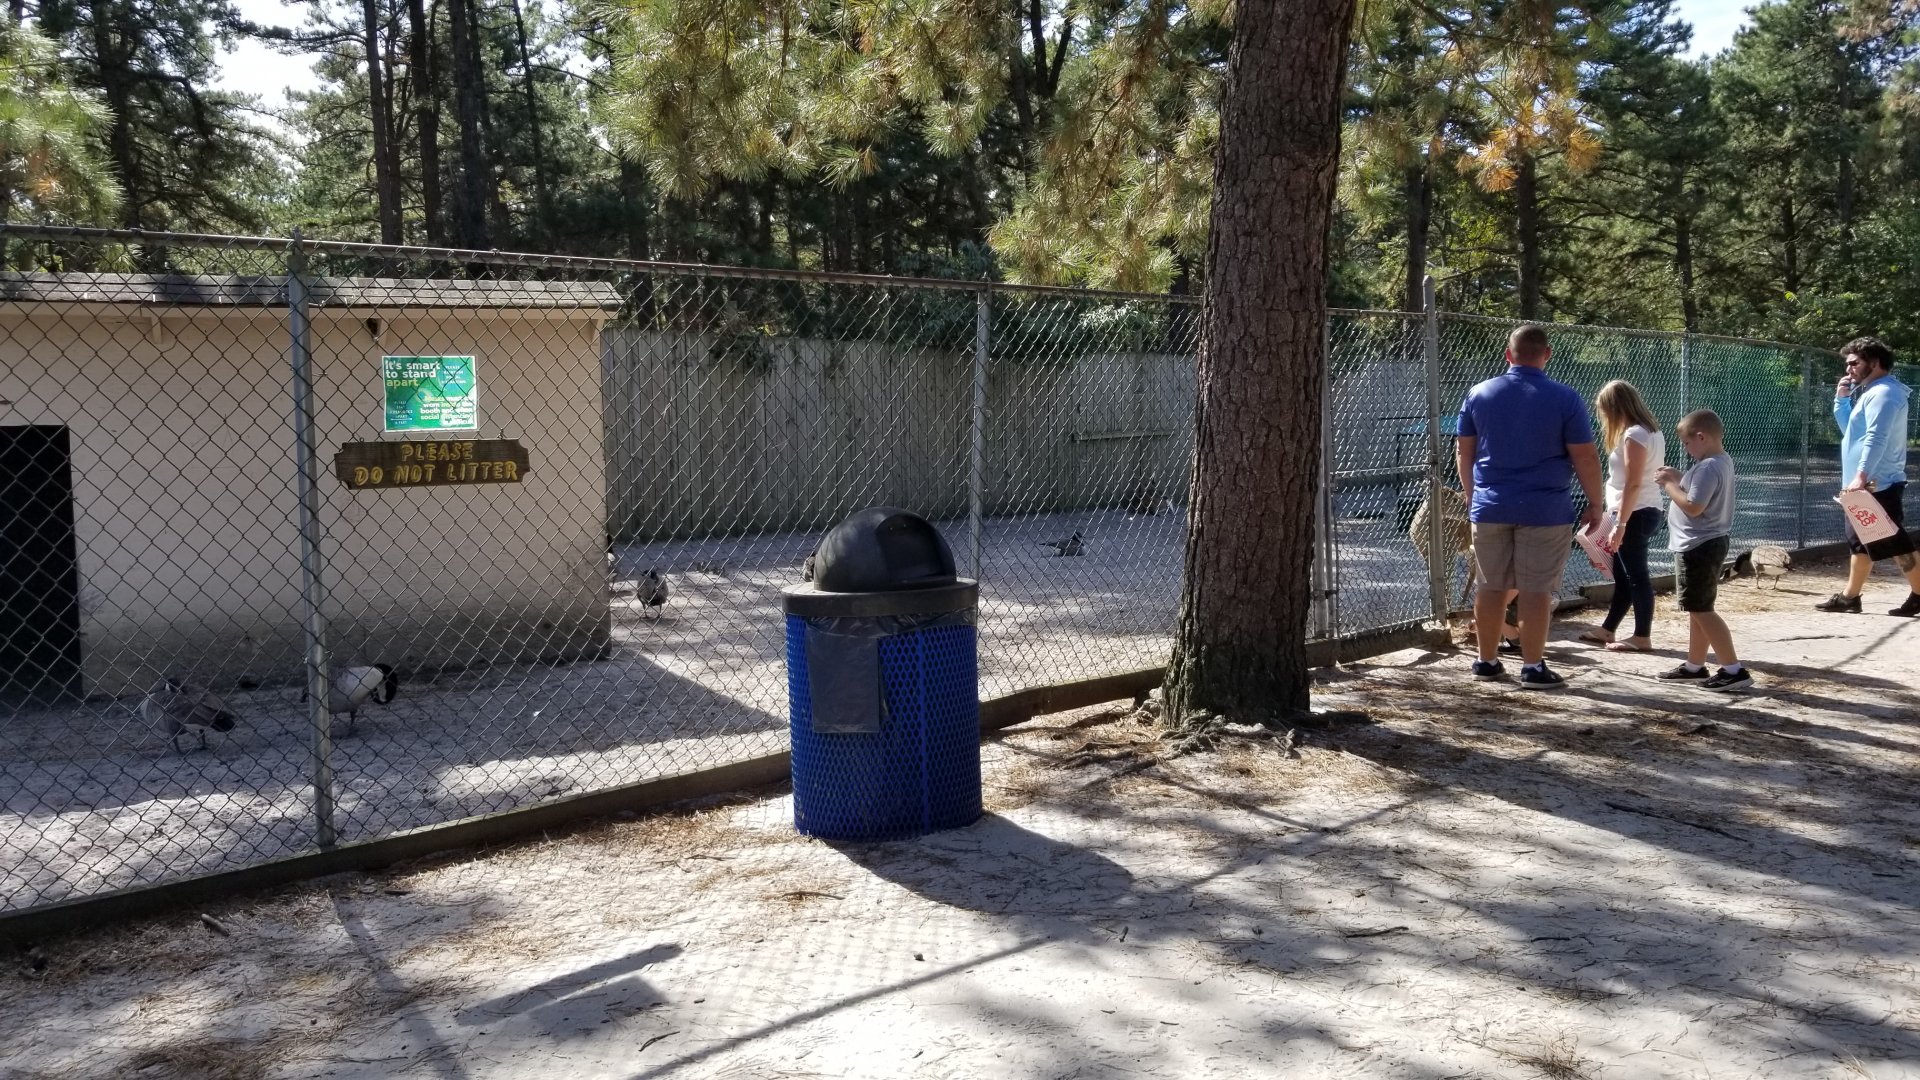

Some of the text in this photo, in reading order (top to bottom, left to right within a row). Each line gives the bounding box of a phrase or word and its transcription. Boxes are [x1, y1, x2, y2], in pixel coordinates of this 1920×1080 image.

[406, 361, 441, 370] smart
[386, 370, 398, 378] to
[402, 368, 437, 378] stand
[401, 442, 474, 461] PLEASE
[354, 460, 519, 486] DO NOT LITTER
